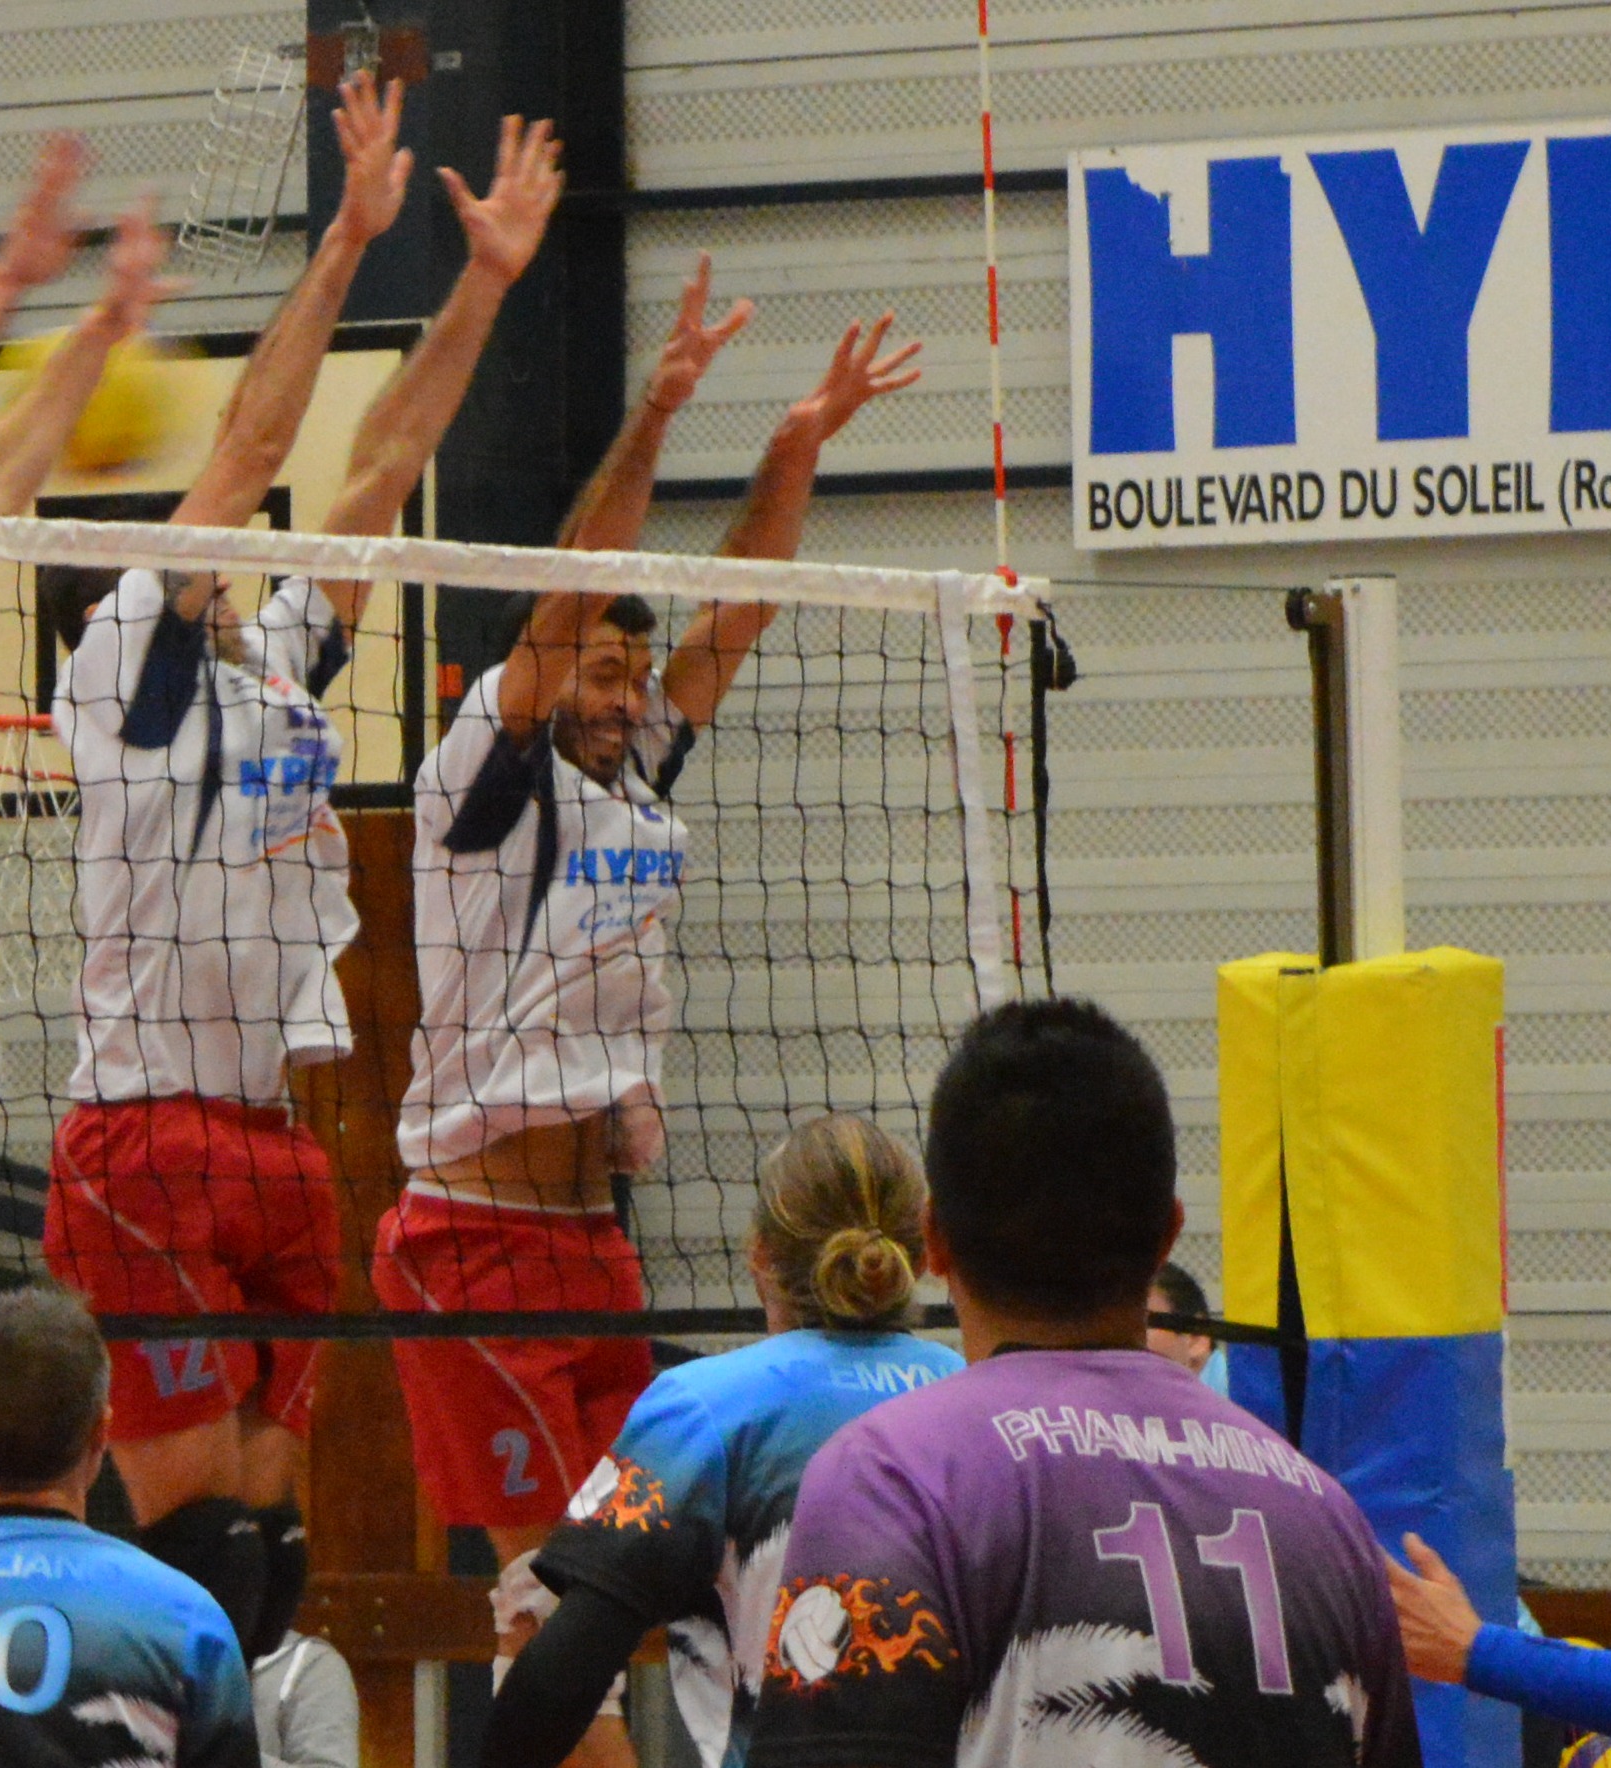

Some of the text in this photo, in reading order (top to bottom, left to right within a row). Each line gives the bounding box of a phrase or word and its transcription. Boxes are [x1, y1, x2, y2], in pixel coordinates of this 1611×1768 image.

[1089, 469, 1326, 532] BOULEVARD
[1339, 467, 1399, 519] DU
[1413, 462, 1545, 518] SOLEIL
[492, 1427, 539, 1498] 2
[991, 1404, 1324, 1497] PHAM-MINH
[1092, 1501, 1294, 1696] 11
